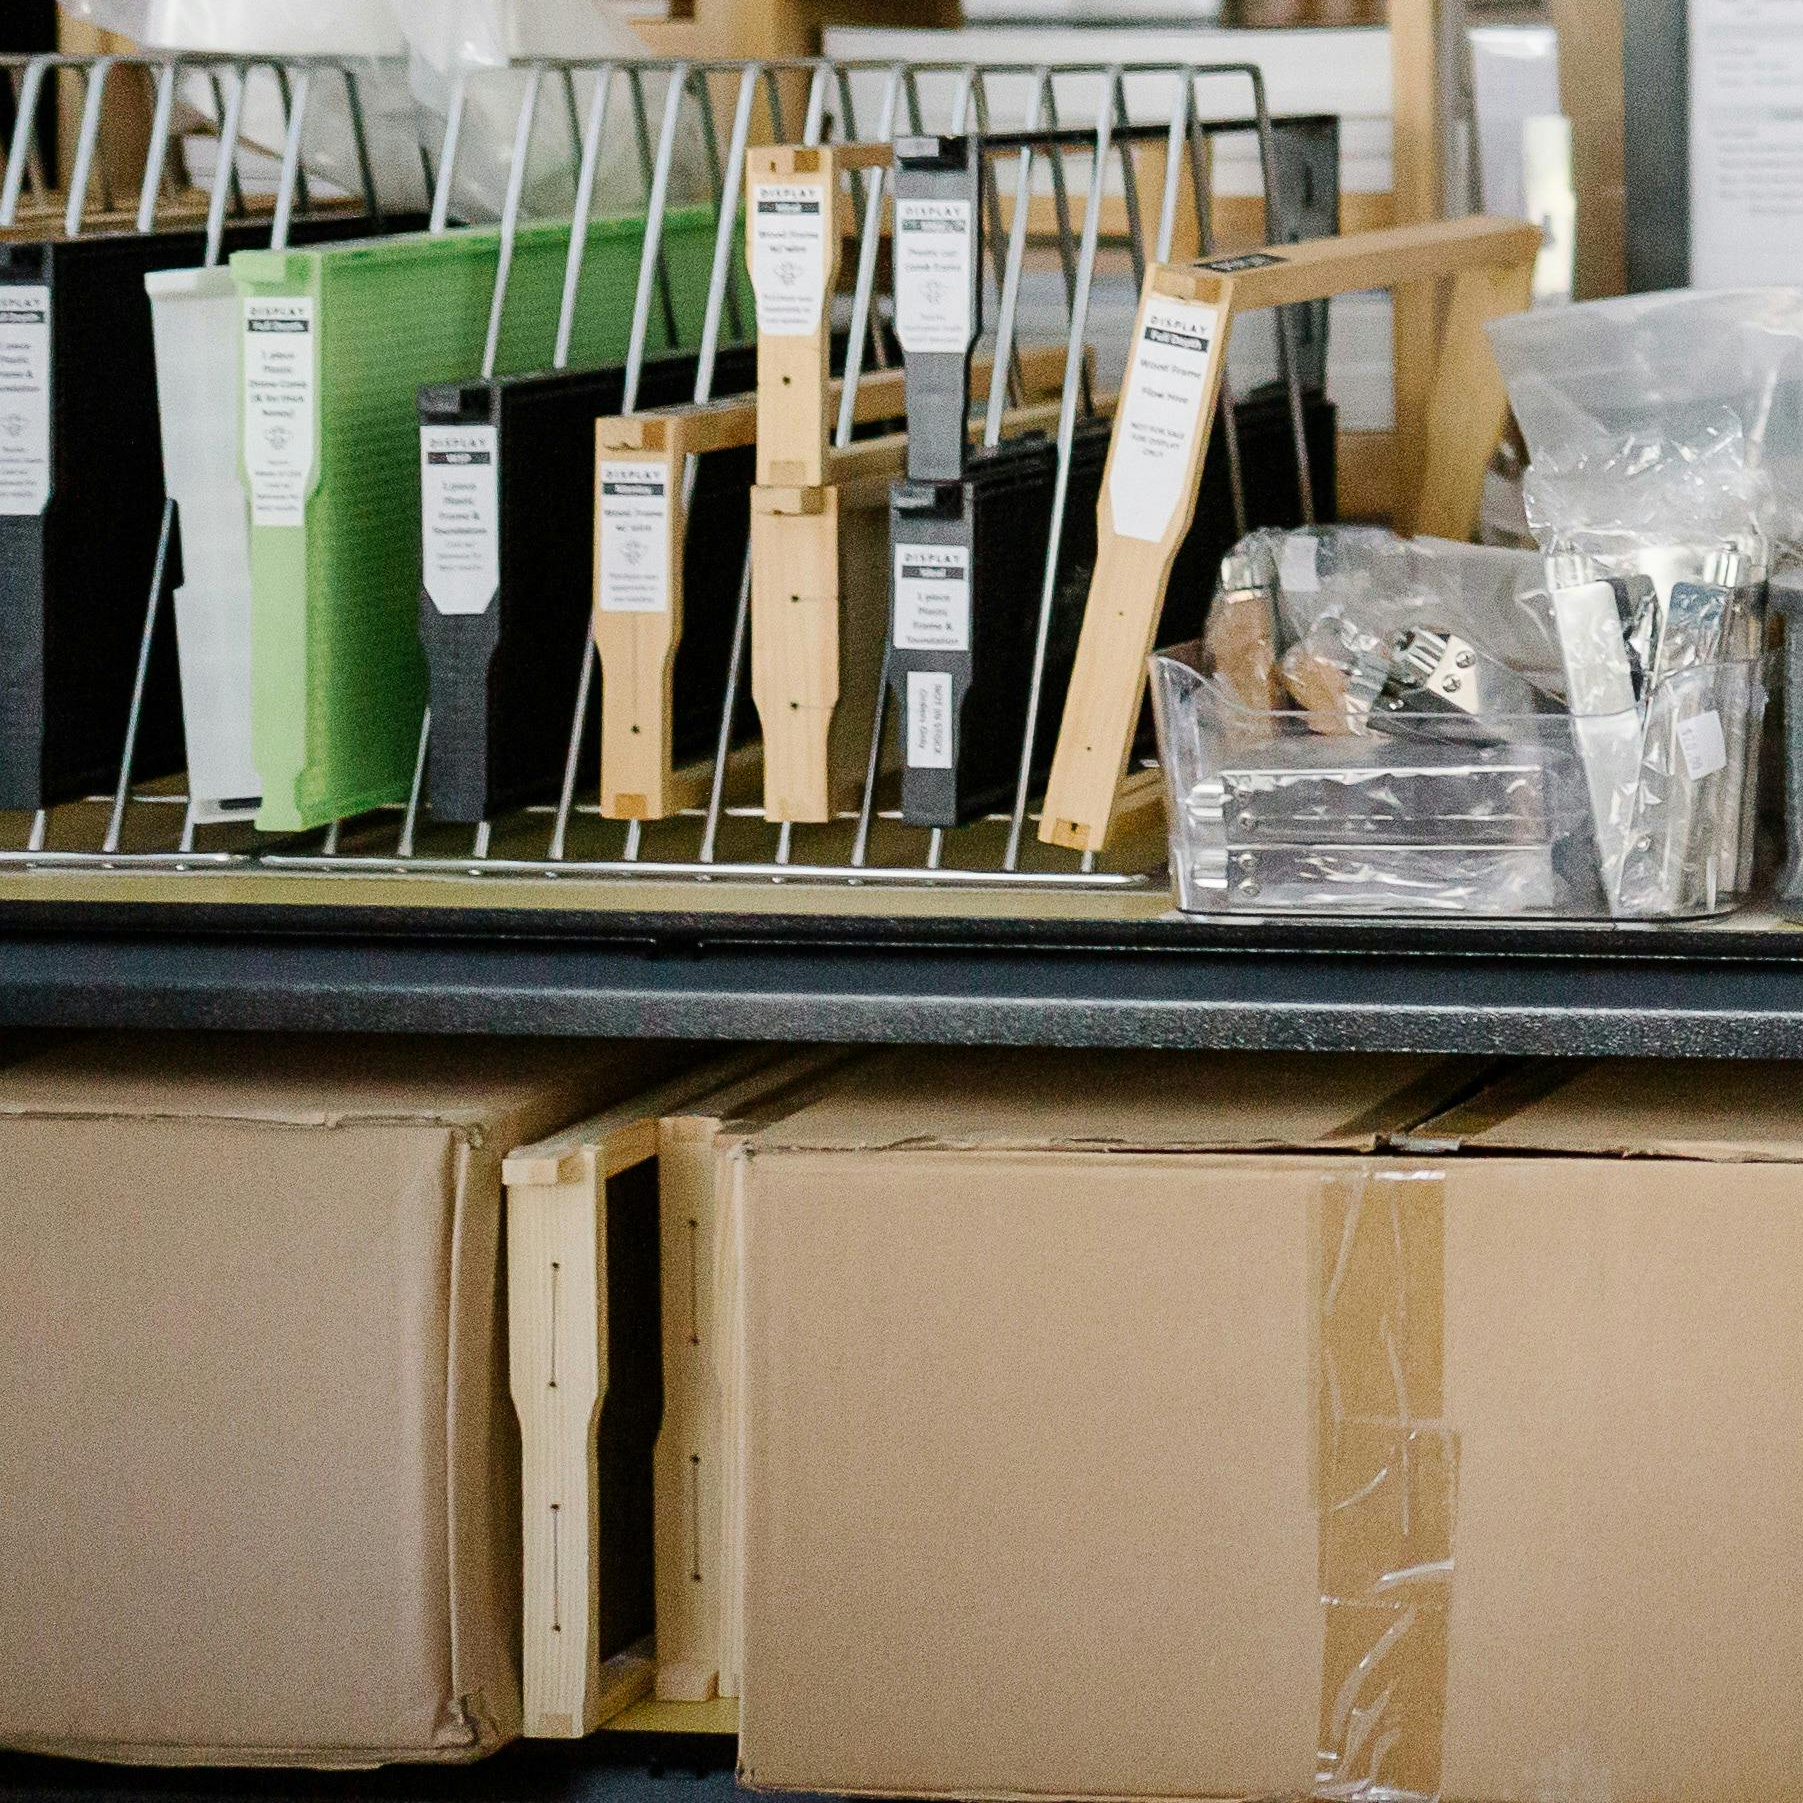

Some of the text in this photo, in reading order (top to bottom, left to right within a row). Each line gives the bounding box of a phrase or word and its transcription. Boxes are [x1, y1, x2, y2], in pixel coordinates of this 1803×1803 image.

[759, 188, 816, 199] DISPLAY
[904, 206, 960, 216] DISPLAY
[249, 306, 305, 316] DISPLAY
[1150, 314, 1208, 336] DISPLAY
[429, 436, 487, 447] DISPLAY
[605, 470, 661, 480] DISPLAY
[904, 552, 960, 564] DISPLAY
